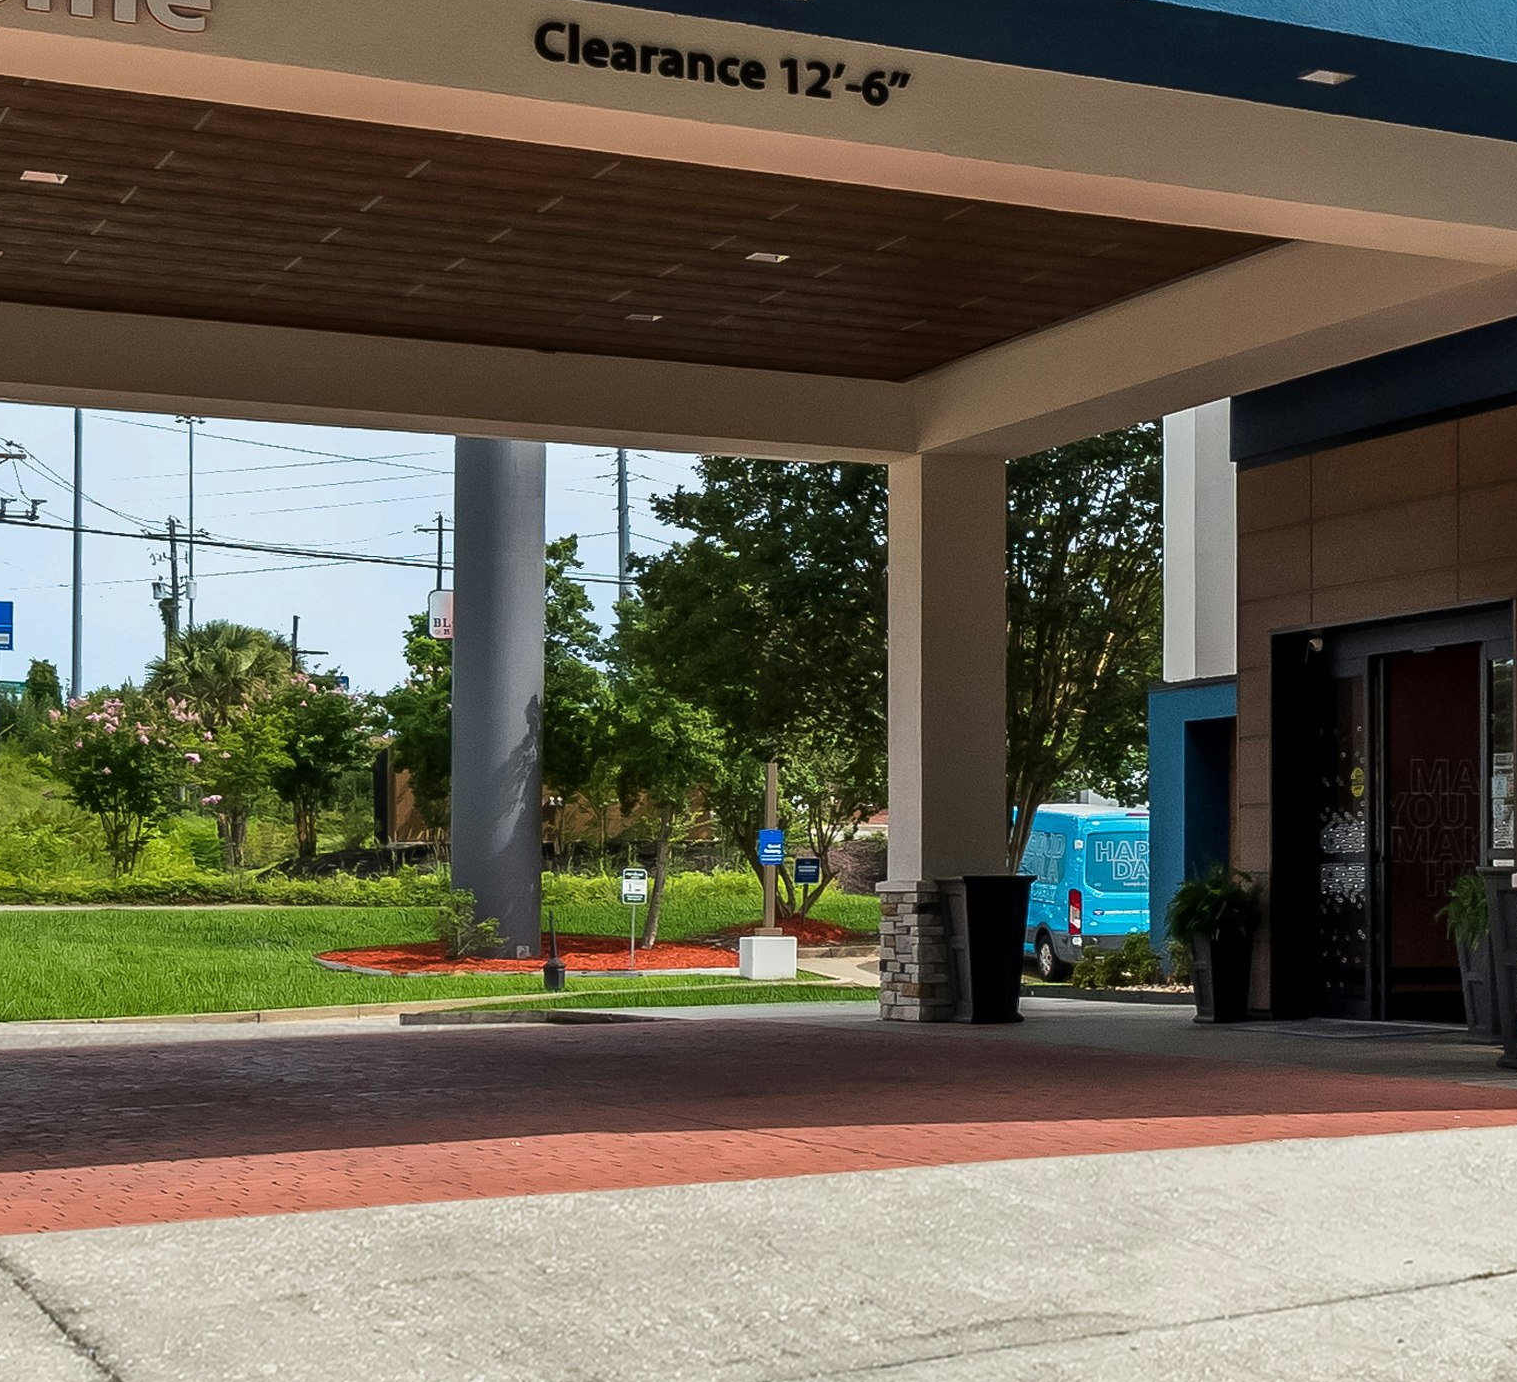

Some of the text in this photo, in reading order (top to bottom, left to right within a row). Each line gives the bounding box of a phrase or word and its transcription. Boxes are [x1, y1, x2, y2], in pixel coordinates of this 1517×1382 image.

[534, 21, 767, 90] Clearance
[1410, 758, 1481, 795] MA
[1095, 840, 1149, 862] HAP
[1390, 826, 1481, 863] MAK
[1112, 859, 1149, 880] DA
